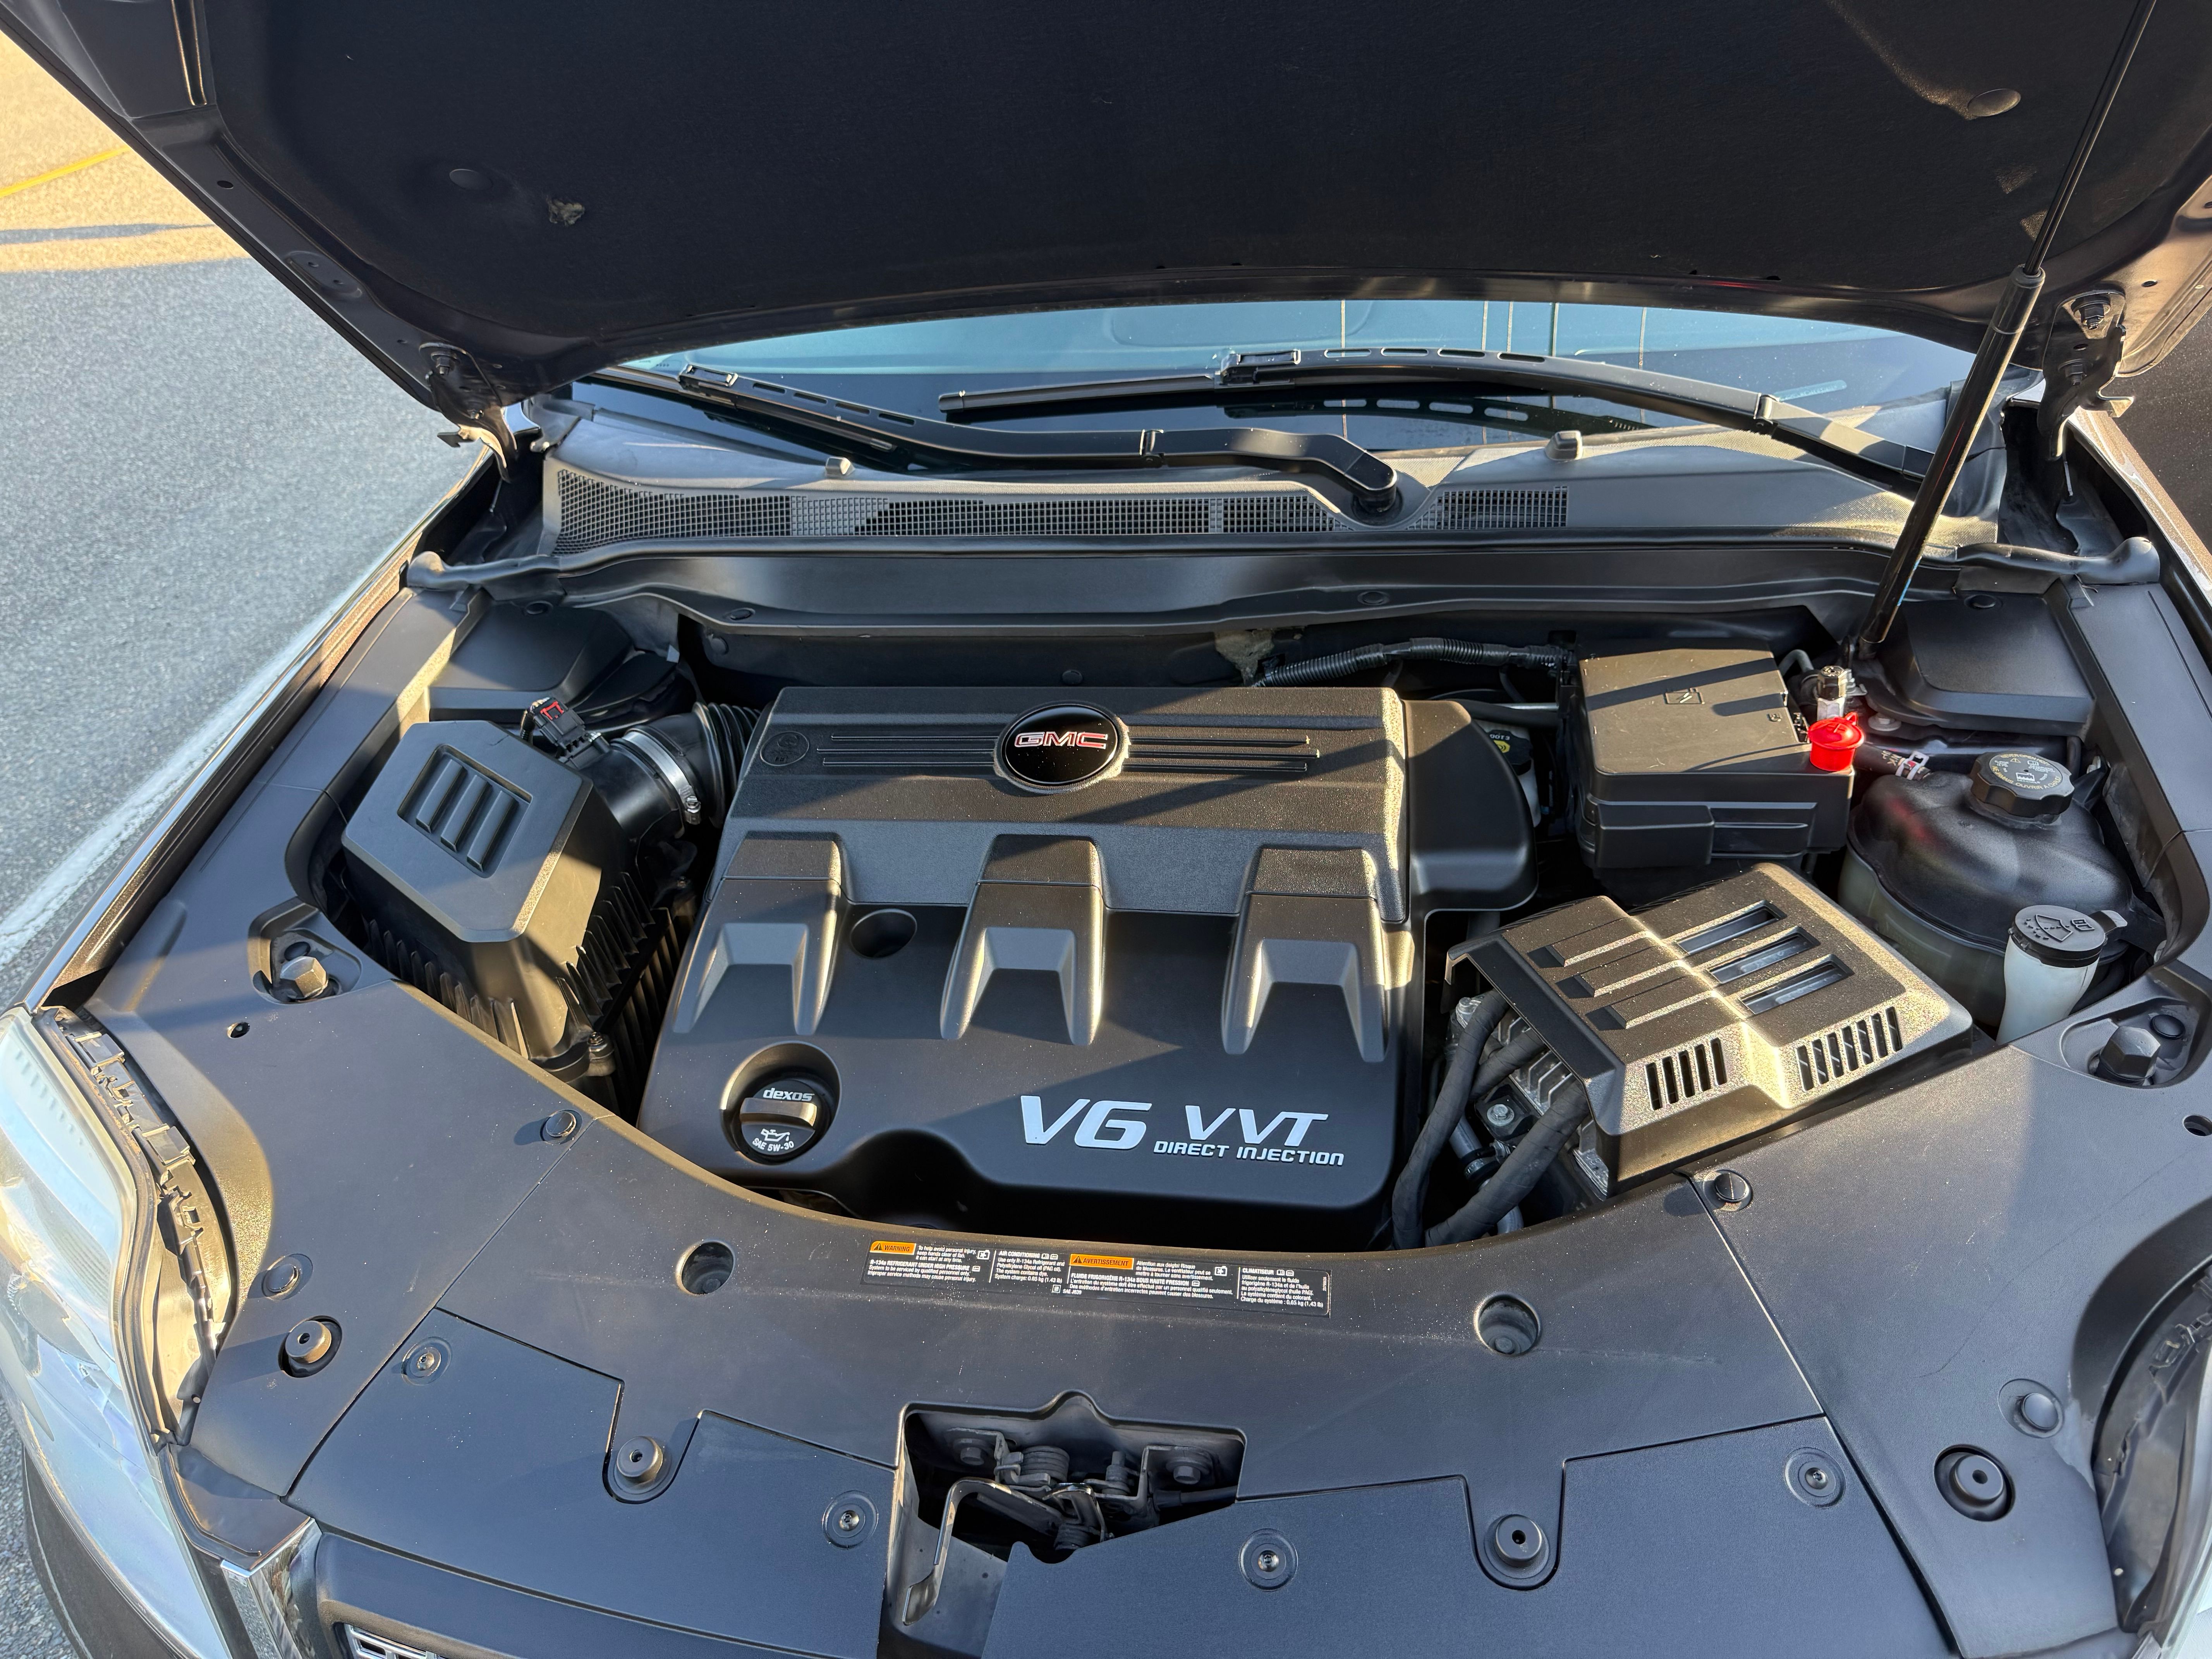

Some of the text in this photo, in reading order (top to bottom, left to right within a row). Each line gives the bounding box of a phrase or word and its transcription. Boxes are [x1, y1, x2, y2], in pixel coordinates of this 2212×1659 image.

[1015, 731, 1108, 750] GMC
[763, 1088, 815, 1101] dexos
[1020, 1095, 1328, 1150] V6 VVT
[752, 1138, 794, 1152] SAE 5W-30
[1153, 1140, 1345, 1167] DIRECT INJECTION
[1083, 1258, 1128, 1266] AVERTISSEMENT
